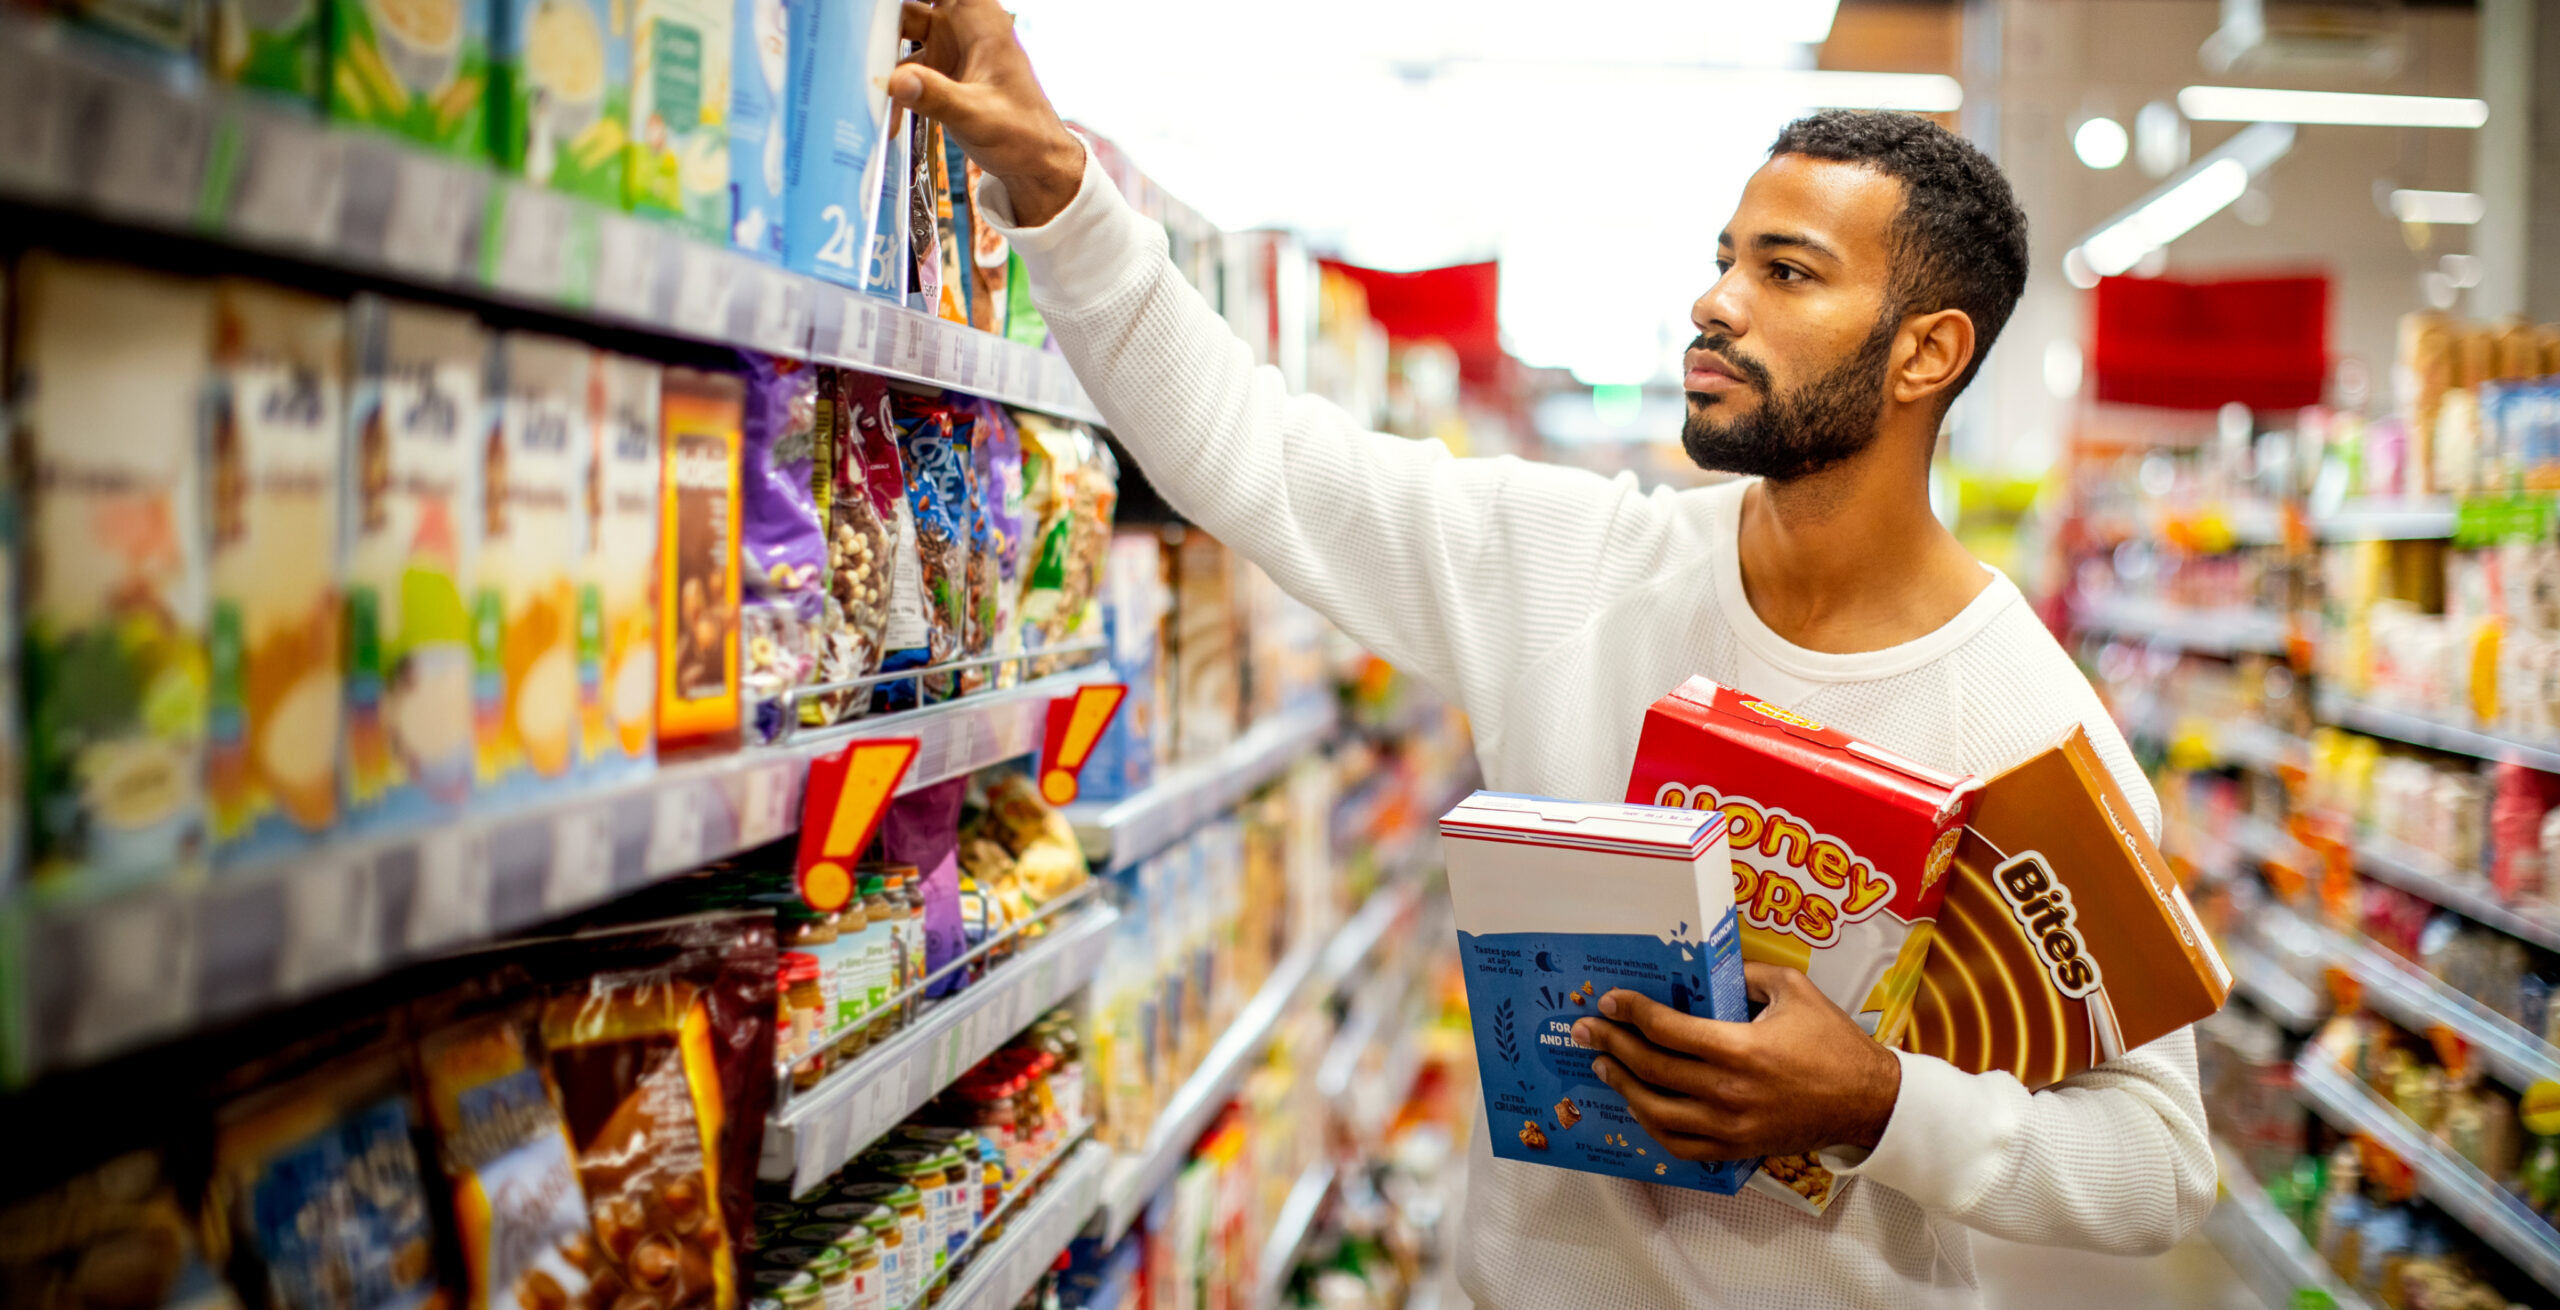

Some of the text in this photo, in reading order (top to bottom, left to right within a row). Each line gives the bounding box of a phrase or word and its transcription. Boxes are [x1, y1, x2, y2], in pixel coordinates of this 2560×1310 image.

[1661, 788, 1890, 916] oney
[1731, 860, 1839, 941] ops
[1710, 916, 1735, 948] CRUNCHY
[2000, 857, 2095, 991] Bites
[1474, 945, 1521, 959] Tastes good
[1479, 963, 1524, 977] time of day
[1497, 958, 1511, 968] any
[1586, 954, 1659, 971] Delicious with milk
[1583, 964, 1667, 982] or herbal alternatives
[1549, 1021, 1571, 1034] FOR
[1540, 1033, 1563, 1046] AND
[1501, 1093, 1526, 1104] EXTRA
[1494, 1101, 1543, 1117] CRUNCHY!
